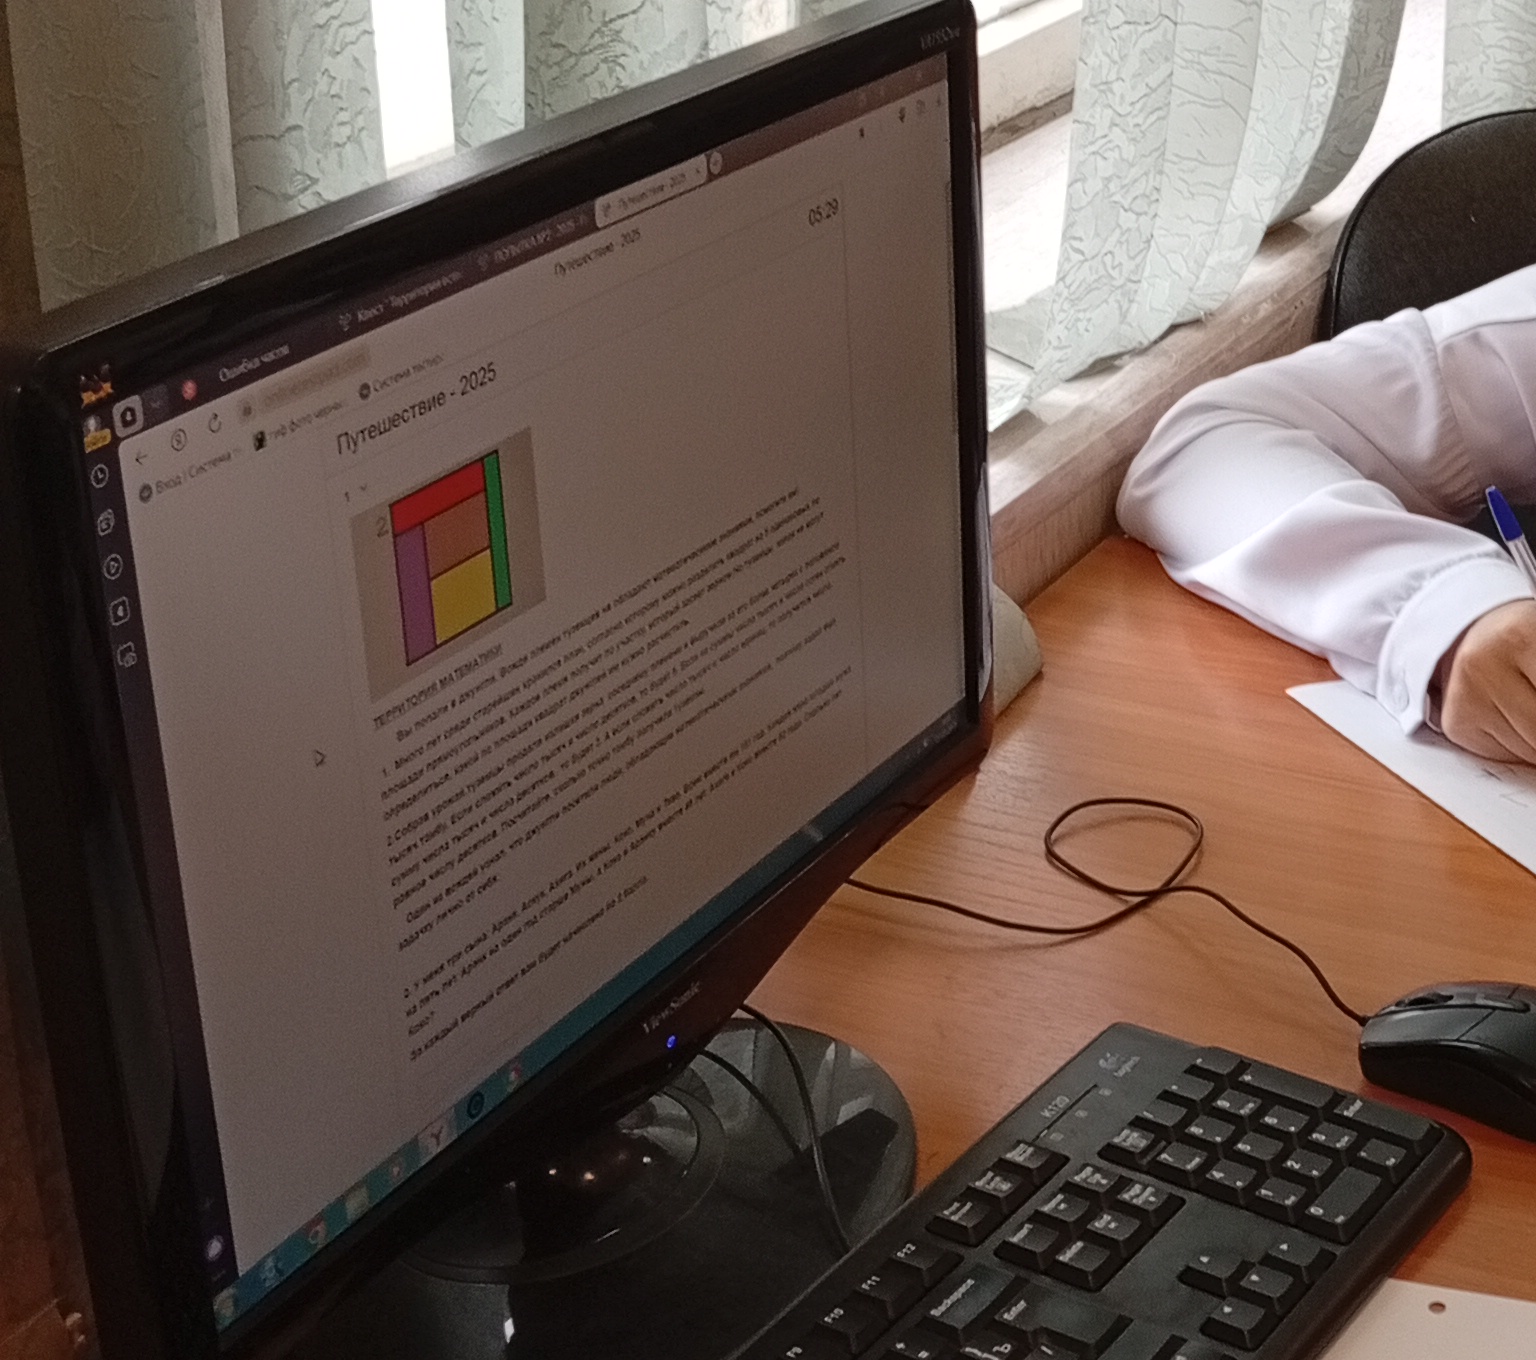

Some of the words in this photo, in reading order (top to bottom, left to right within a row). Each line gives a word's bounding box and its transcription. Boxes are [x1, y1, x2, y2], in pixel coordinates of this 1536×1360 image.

[807, 195, 839, 228] 05:29
[335, 392, 448, 456] Путешествие
[458, 358, 498, 400] 2025
[1039, 1095, 1070, 1117] K120
[823, 1307, 844, 1323] F10
